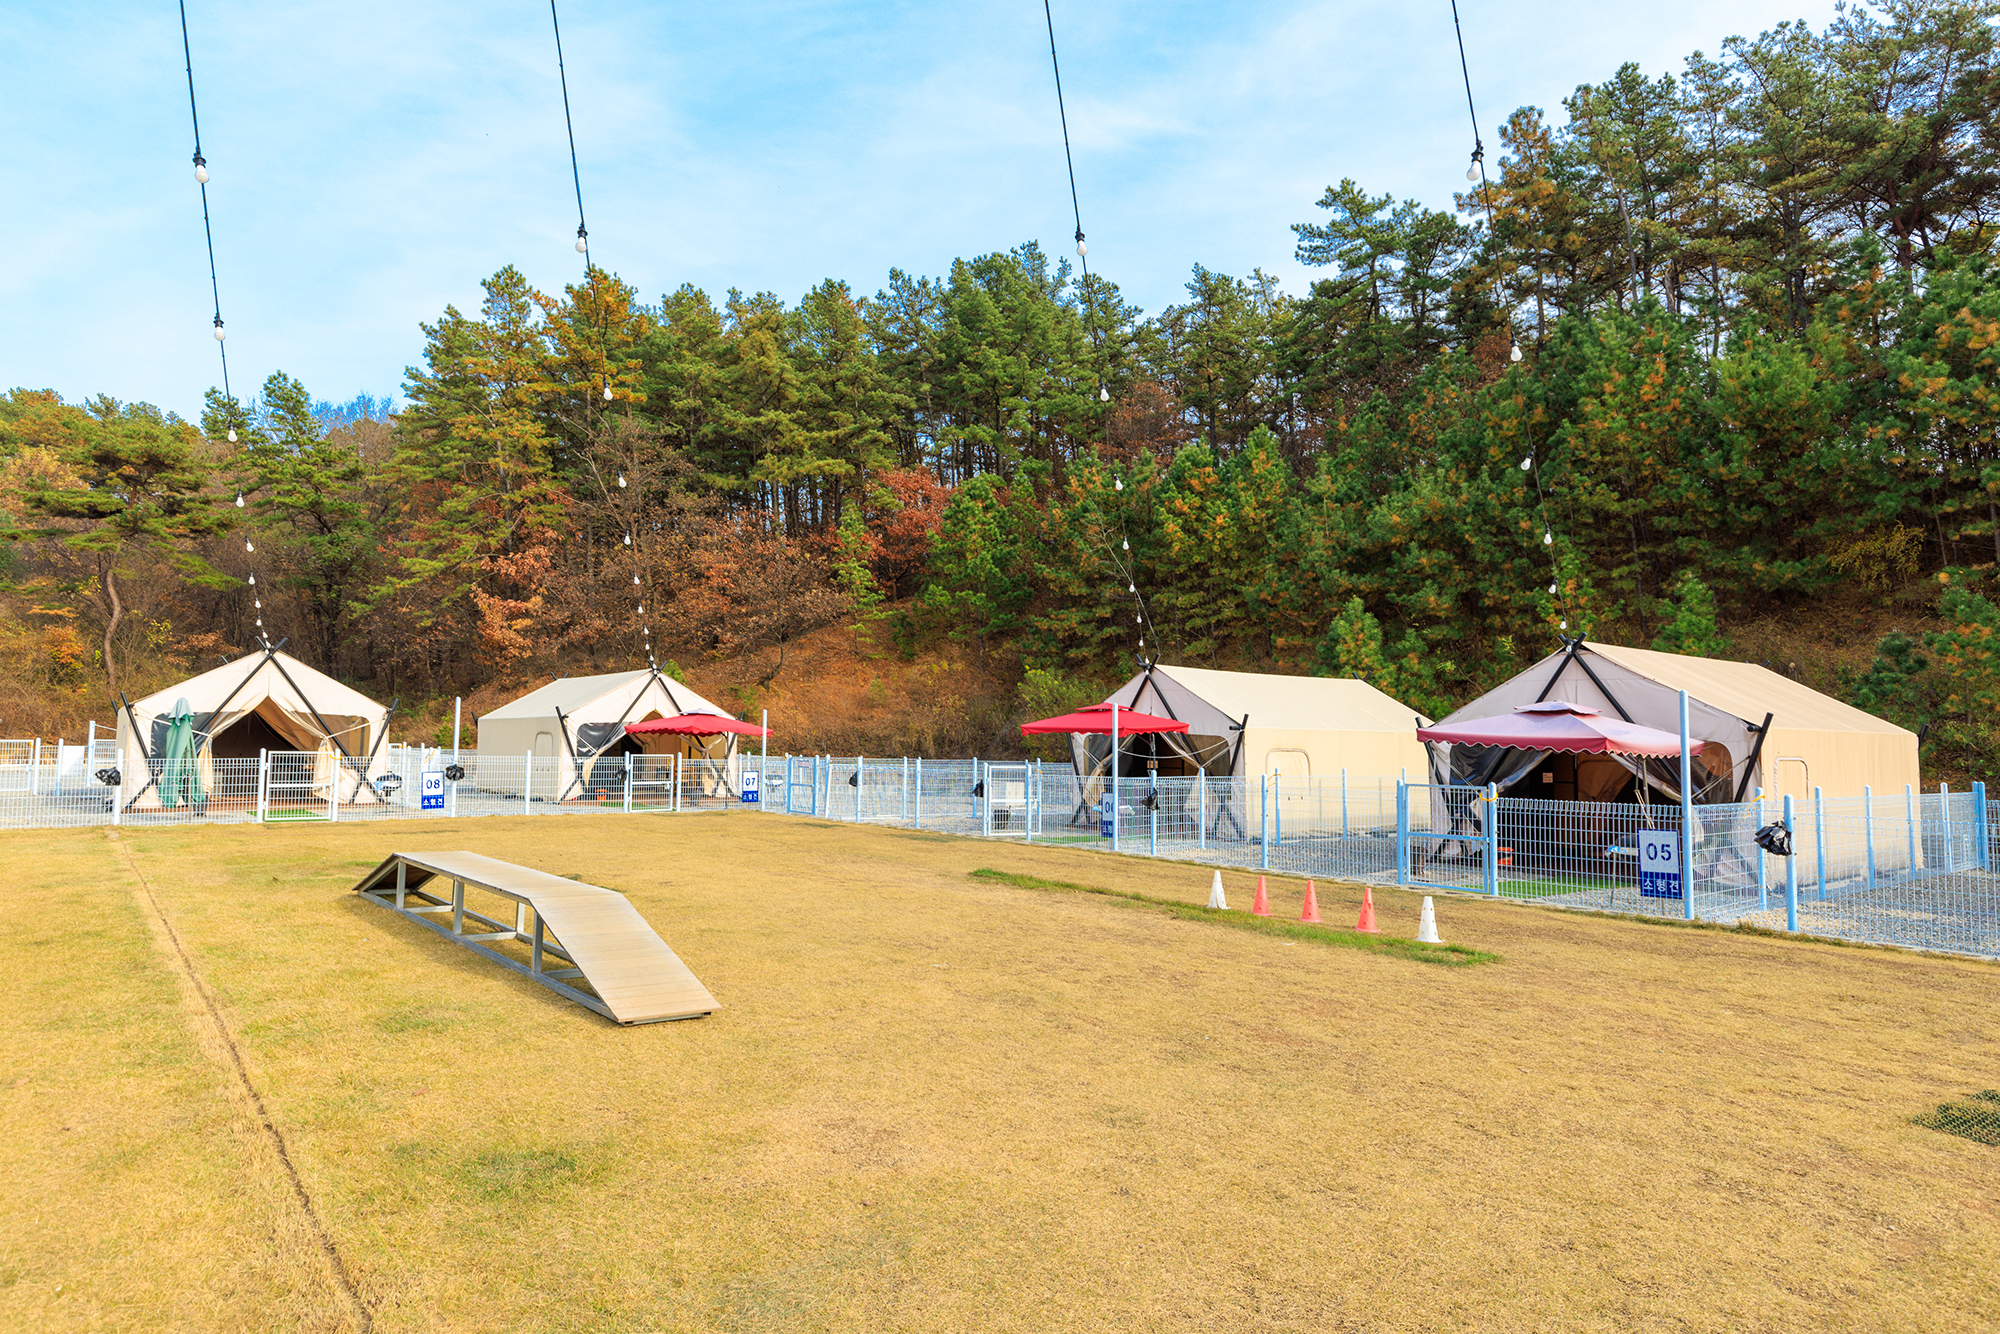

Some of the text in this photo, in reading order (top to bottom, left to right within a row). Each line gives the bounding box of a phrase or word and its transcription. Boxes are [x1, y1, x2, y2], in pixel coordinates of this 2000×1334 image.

[426, 779, 440, 789] 08
[745, 778, 755, 786] 07
[1646, 843, 1671, 861] 05
[1644, 879, 1678, 893] 소형견
